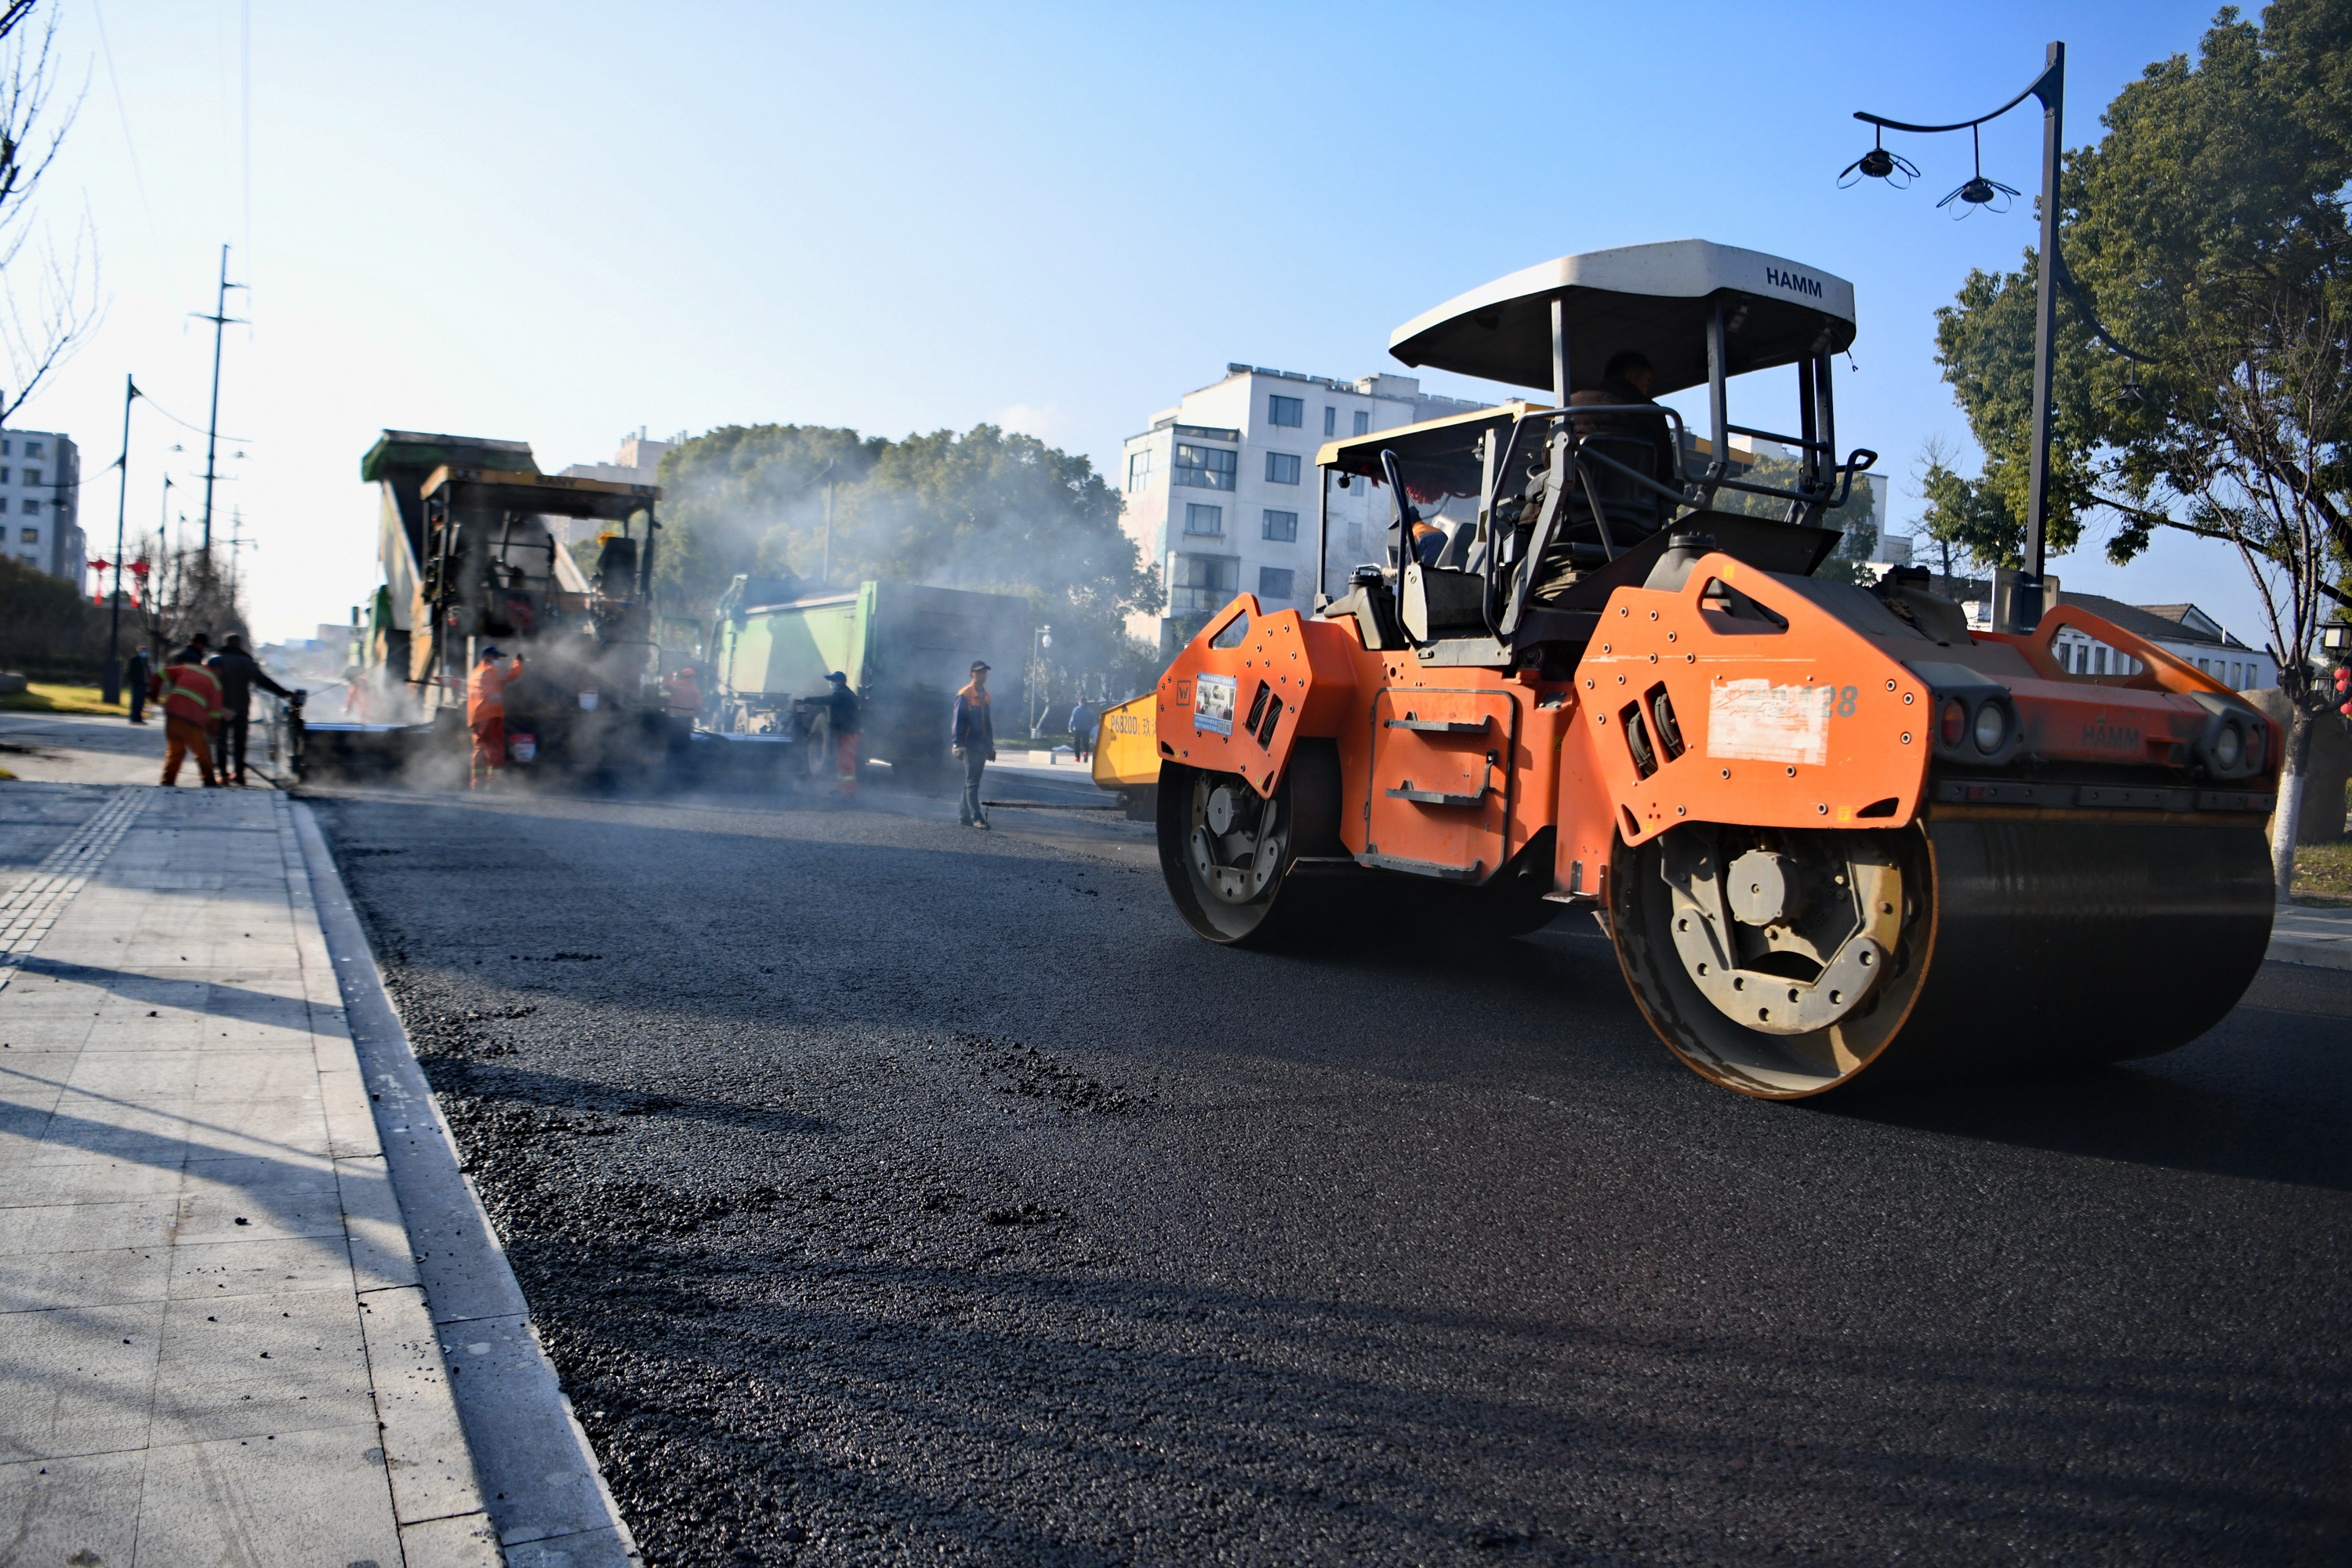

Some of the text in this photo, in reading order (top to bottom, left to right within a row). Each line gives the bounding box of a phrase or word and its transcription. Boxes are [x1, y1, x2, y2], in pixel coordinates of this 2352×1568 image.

[1766, 267, 1823, 299] HAMM
[535, 475, 577, 488] SANY
[2082, 724, 2140, 750] HAMM
